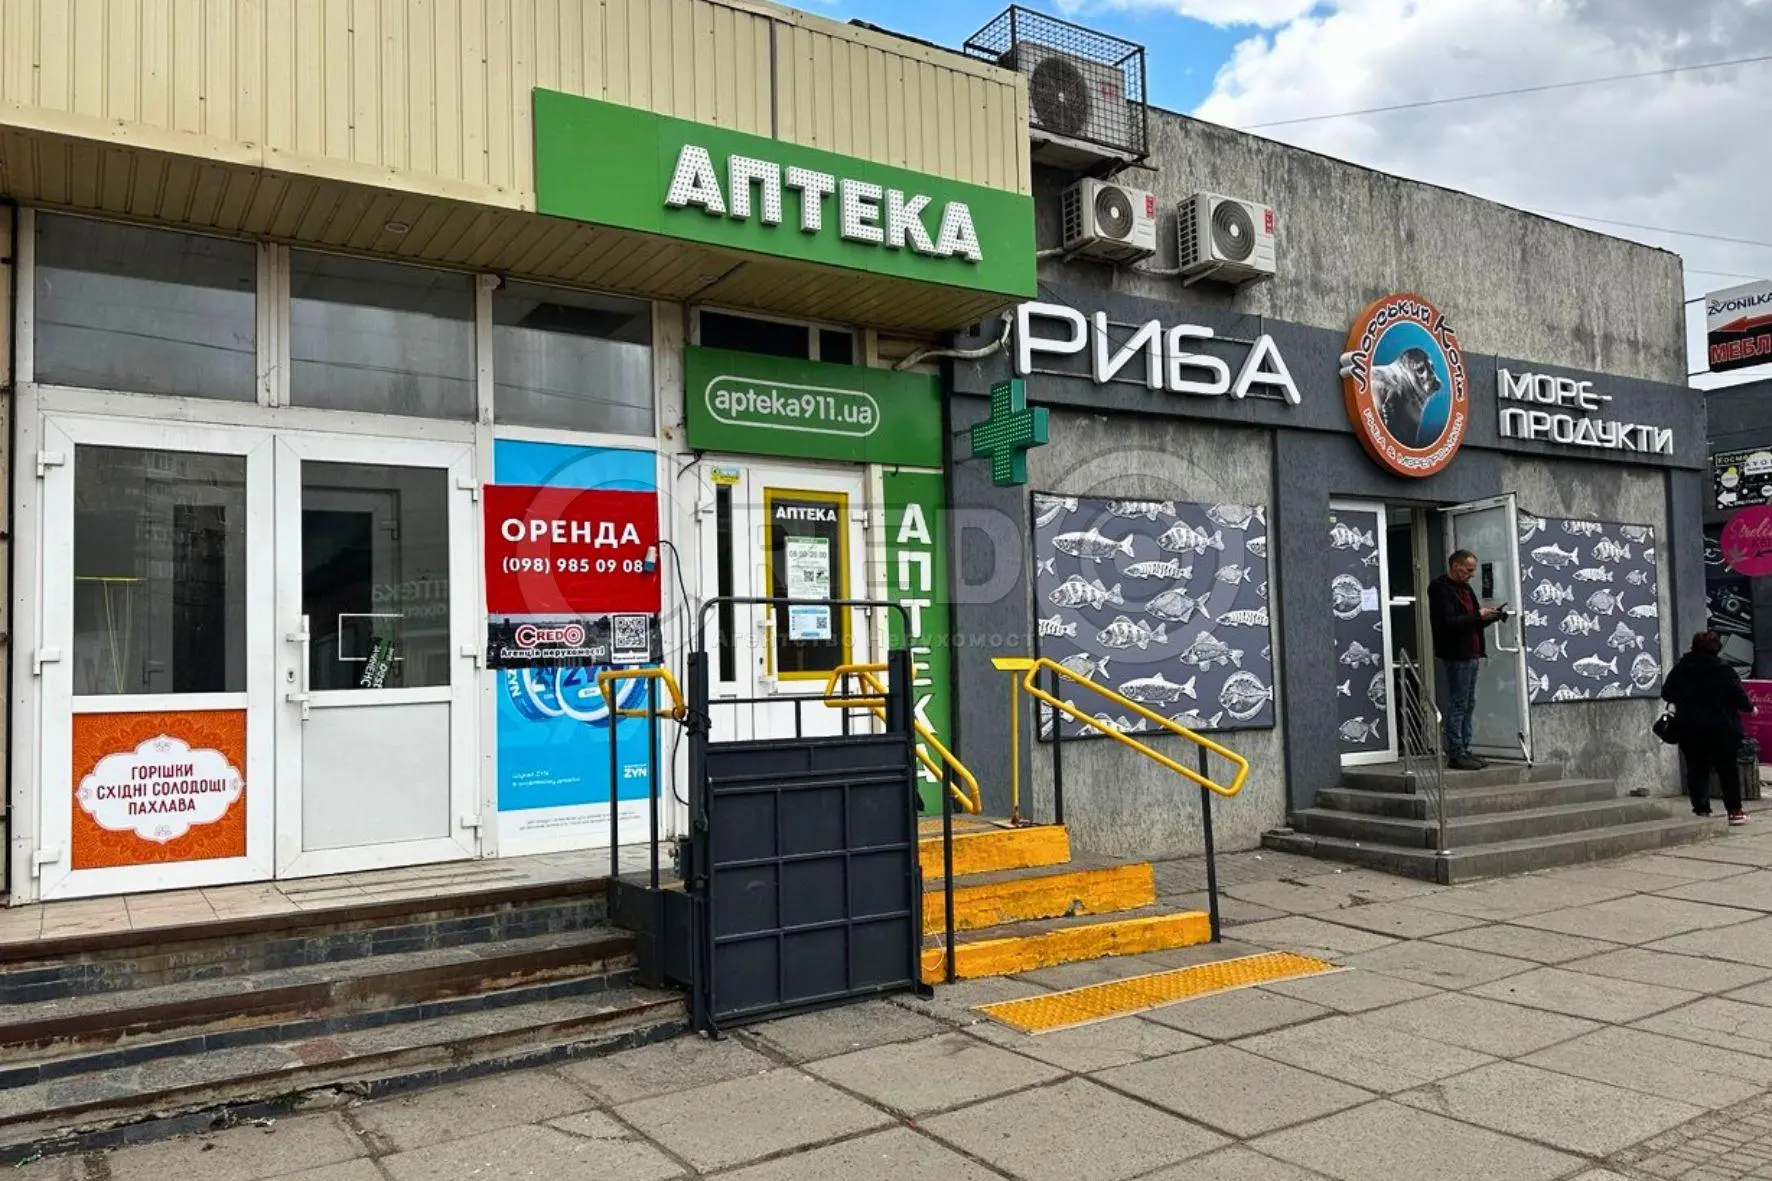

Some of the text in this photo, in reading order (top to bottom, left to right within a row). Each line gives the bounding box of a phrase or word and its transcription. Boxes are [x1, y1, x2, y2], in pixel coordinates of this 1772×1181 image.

[664, 144, 983, 263] АПТЕКА
[1015, 301, 1301, 405] РИБА
[1498, 368, 1613, 410] МОРЕ-
[714, 388, 873, 425] apteka911.ua
[1500, 407, 1674, 455] ПРОДУКТИ
[775, 506, 837, 522] АПТЕКА
[501, 518, 641, 548] ОРЕНДА
[503, 557, 644, 573] (098) 985 09 08
[515, 624, 585, 647] CREDO
[131, 763, 194, 780] ГОРІШКИ
[624, 768, 648, 778] ZYN
[96, 779, 226, 800] СХІДНІ СОЛОДОЩІ
[128, 798, 196, 815] ПАХЛАВА
